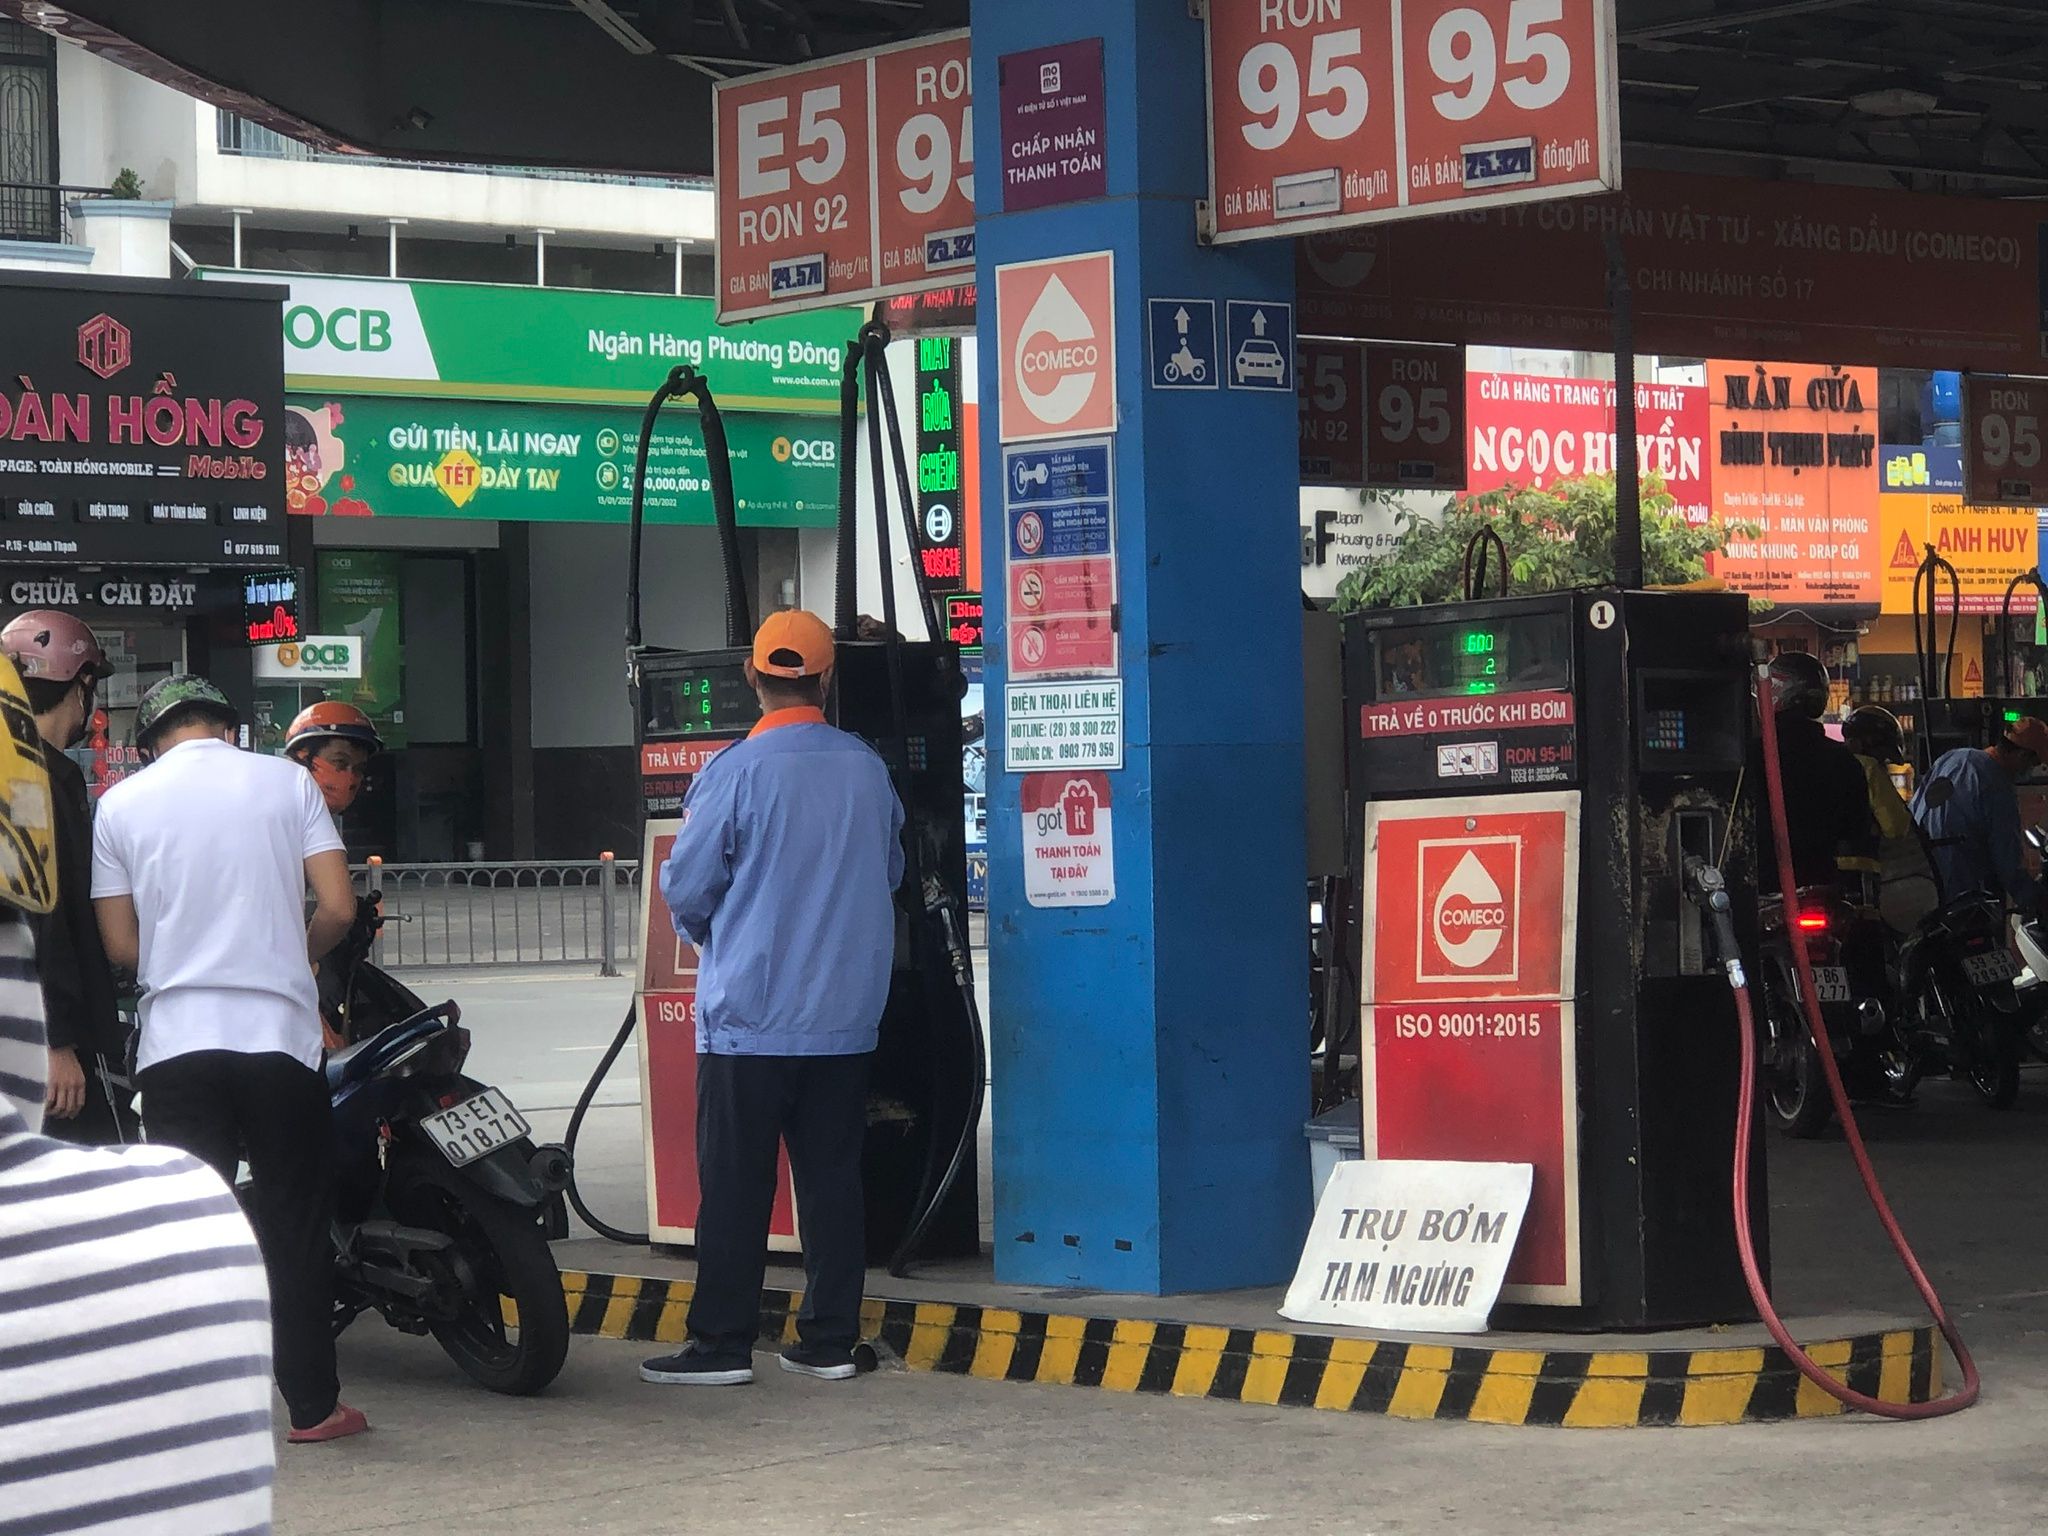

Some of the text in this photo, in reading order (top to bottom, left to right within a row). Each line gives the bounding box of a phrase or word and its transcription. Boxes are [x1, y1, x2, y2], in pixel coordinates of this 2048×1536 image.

[1428, 0, 1571, 121] 95
[1237, 28, 1369, 151] 95
[737, 84, 847, 200] E5
[1012, 126, 1096, 159] CHẤP NHẬN
[1008, 151, 1102, 185] THANH TOÁN
[1412, 159, 1431, 188] GIÁ
[1542, 138, 1591, 170] đồng/lít
[1224, 169, 1388, 217] GIÁ BÁN: đồng/lít
[738, 193, 848, 247] RON 92
[284, 304, 392, 352] OCB
[588, 329, 840, 372] Ngân Hàng Phương Đông
[1023, 345, 1098, 374] COMECO
[772, 376, 840, 387] www.ocb.com.vn
[1392, 358, 1437, 382] RON
[1480, 373, 1508, 400] CỬA
[1514, 377, 1550, 404] HÀNG
[1554, 384, 1599, 406] TRANG
[1652, 383, 1685, 412] THẤT
[1724, 364, 1865, 413] MÀN CỬA
[1990, 390, 2029, 410] RON
[108, 372, 264, 448] HỒNG
[1379, 384, 1451, 445] 95
[389, 422, 581, 457] GỬI TIỀN, LÃI NGAY
[1325, 420, 1348, 442] 92
[1980, 414, 2041, 468] 95
[792, 440, 836, 461] OCB
[1473, 424, 1575, 489] NGỌC
[40, 458, 72, 475] TOÀN
[74, 457, 109, 475] HỒNG
[110, 464, 154, 477] MOBILE
[188, 454, 267, 480] Mobile
[389, 454, 561, 491] QUÀ TẾT ĐẦY TAY
[1334, 511, 1364, 526] Japan
[1931, 502, 1955, 514] CÔNG
[1956, 504, 1966, 514] TY
[1780, 514, 1806, 533] MÀN
[1832, 514, 1869, 534] PHÒNG
[265, 544, 280, 556] 1111
[1336, 533, 1374, 550] Housing
[1727, 538, 1860, 560] MÙNG KHUNG DRAP GỐI
[1937, 527, 2029, 553] ANH HUY
[10, 576, 196, 612] CHỮA CÀI ĐẶT
[1596, 606, 1608, 625] 1
[301, 644, 350, 666] OCB
[1011, 688, 1116, 716] ĐIỆN THOẠI LIÊN HỆ
[1369, 700, 1566, 732] TRẢ VỀ 0 TRƯỚC KHI BƠM
[1011, 722, 1047, 738] HOTLINE:
[1048, 722, 1068, 738] (28)
[1082, 720, 1098, 736] 300
[1100, 720, 1116, 736] 222
[646, 746, 698, 768] TRẢ VỀ 0
[1059, 742, 1079, 760] 0903
[1082, 742, 1098, 758] 779
[1098, 742, 1114, 758] 359
[1505, 748, 1536, 764] RON
[1037, 804, 1087, 837] got it
[1034, 841, 1102, 860] THANH TOÁN
[1050, 863, 1088, 883] TẠI ĐÂY
[1440, 908, 1504, 926] COMECO
[658, 1000, 686, 1024] ISO
[1396, 1013, 1540, 1038] ISO 9001:2015
[434, 1096, 498, 1136] 73-E1
[446, 1113, 523, 1160] 018.71
[1338, 1202, 1508, 1252] TRỤ BƠM
[1320, 1262, 1380, 1308] TẠM
